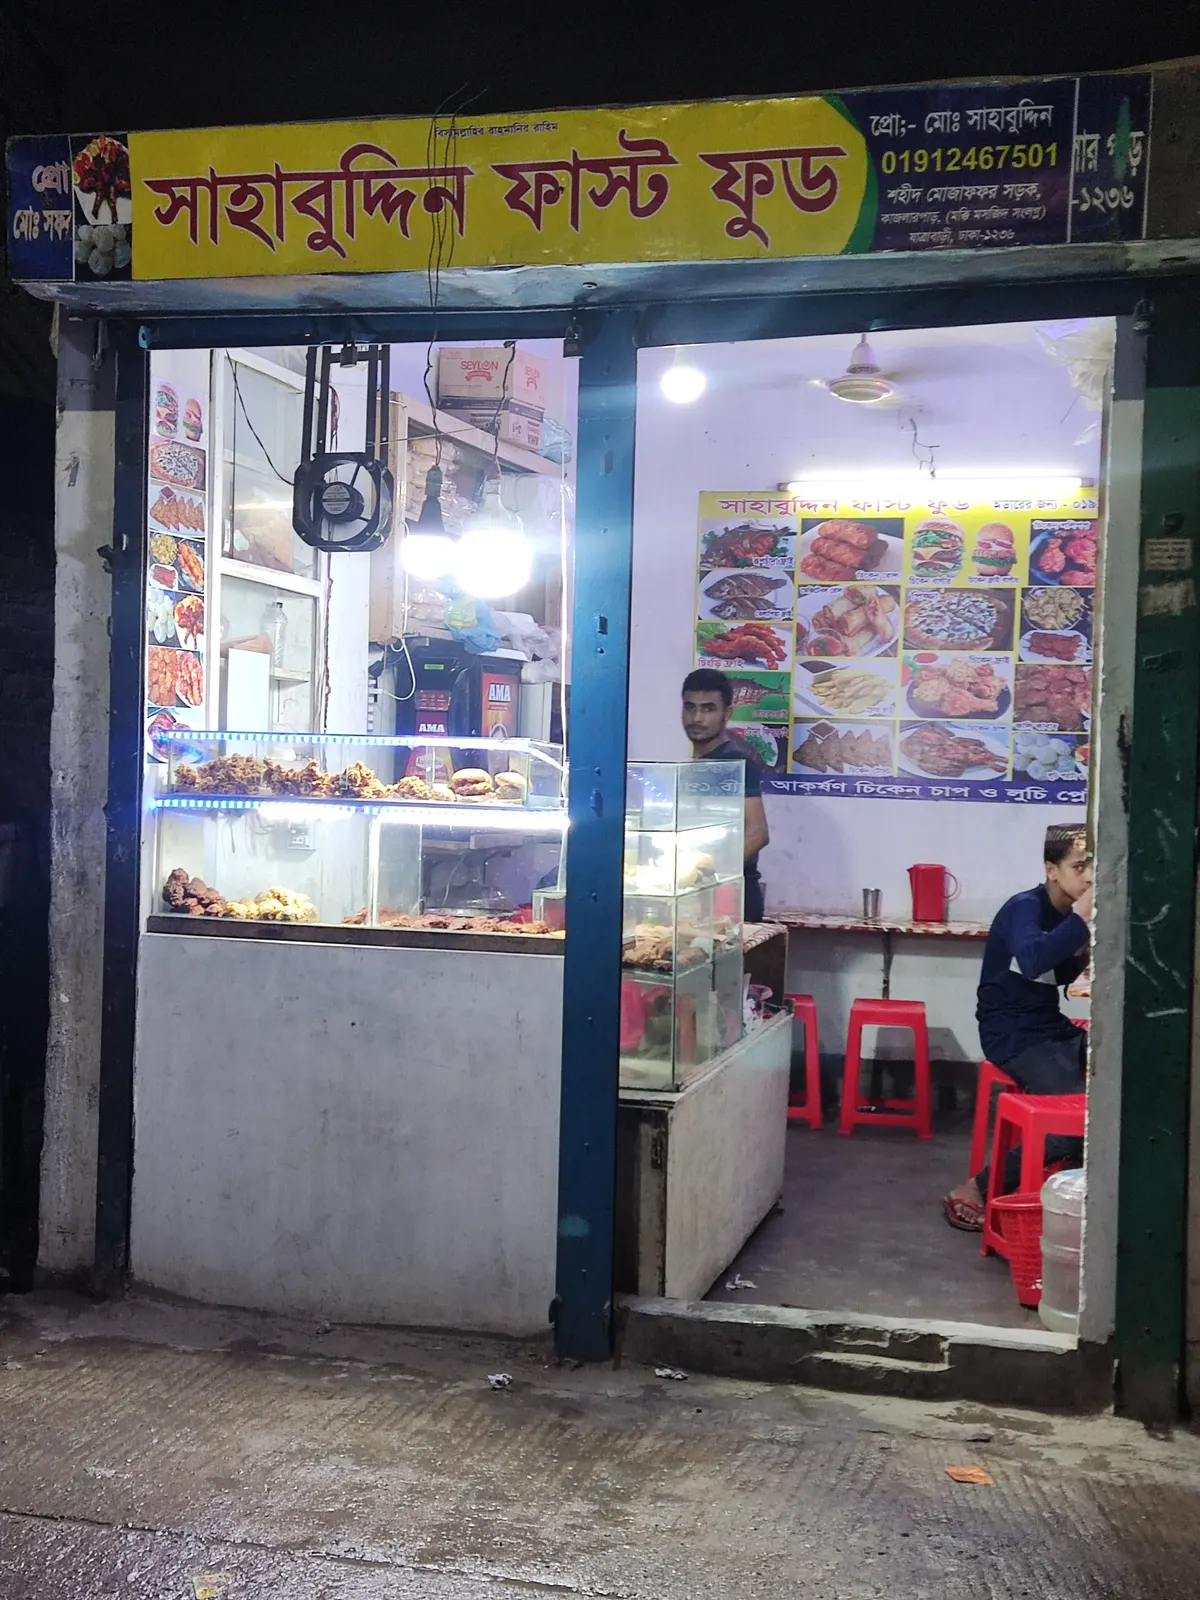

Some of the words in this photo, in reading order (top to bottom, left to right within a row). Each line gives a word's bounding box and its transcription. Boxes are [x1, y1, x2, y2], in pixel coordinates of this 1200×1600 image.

[924, 109, 960, 135] মোঃ
[965, 98, 1055, 133] সাহাবুদ্দিন
[881, 141, 1059, 175] 01912467501
[143, 143, 474, 258] সাহাবুদ্দিন
[490, 129, 679, 233] ফাস্ট
[699, 146, 847, 249] ফুড
[887, 183, 923, 205] শহীদ
[460, 360, 499, 371] SEYLON
[718, 496, 838, 516] সাহাবুদ্দিন
[488, 683, 511, 702] AMA
[418, 723, 446, 734] AMA
[770, 778, 848, 793] আকর্ষণ
[853, 780, 920, 797] চিকেন
[929, 784, 969, 799] চাপ
[978, 787, 998, 799] ও
[1004, 785, 1049, 803] লুচি
